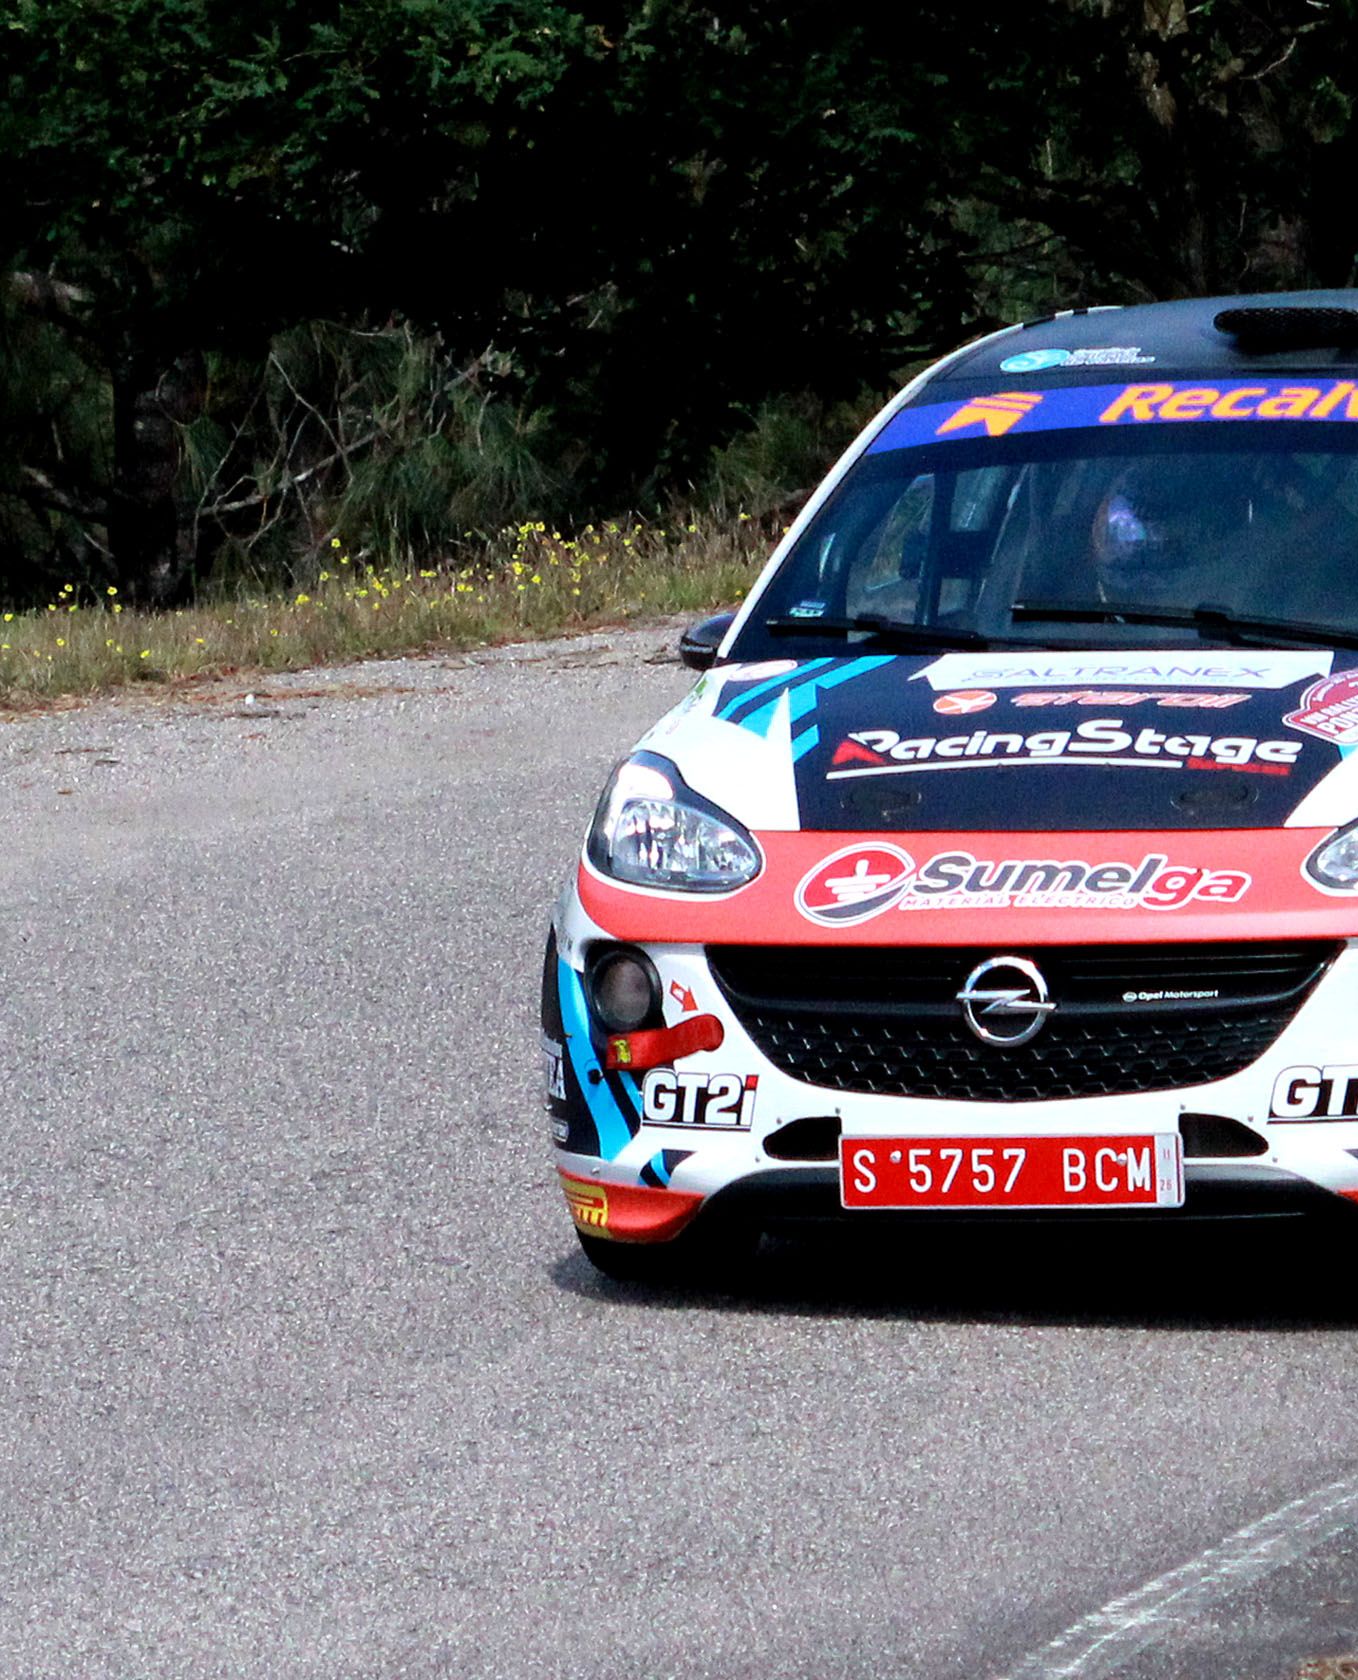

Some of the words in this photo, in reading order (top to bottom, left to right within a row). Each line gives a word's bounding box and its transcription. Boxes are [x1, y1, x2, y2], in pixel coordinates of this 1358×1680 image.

[972, 667, 1271, 680] SALTRANEX
[832, 720, 1302, 768] RacingStage
[904, 898, 1007, 908] MATERIAL
[911, 853, 1252, 910] Sumelga
[1138, 991, 1164, 1001] Opel
[1164, 989, 1219, 999] Motorsport
[645, 1068, 759, 1131] GT2i
[853, 1150, 876, 1193] S
[907, 1149, 1026, 1192] 5757
[1062, 1148, 1152, 1192] BCM
